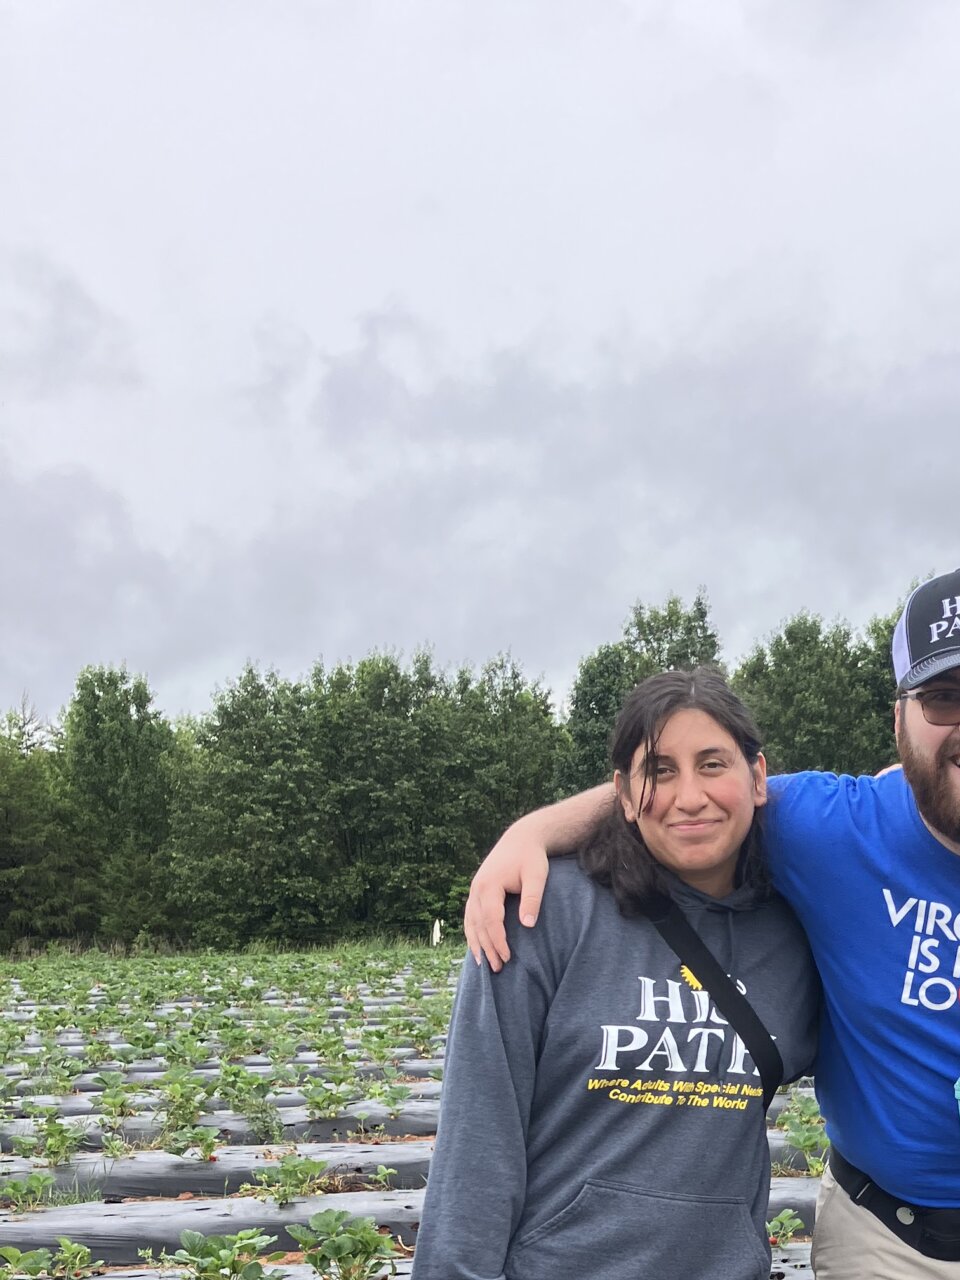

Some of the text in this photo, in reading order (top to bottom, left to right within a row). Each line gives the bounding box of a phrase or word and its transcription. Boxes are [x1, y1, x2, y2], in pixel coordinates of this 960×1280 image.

[908, 935, 940, 973] IS
[636, 975, 747, 1025] HI
[587, 1078, 629, 1090] Where
[631, 1079, 670, 1091] Adults
[609, 1088, 673, 1105] Contribute
[687, 1095, 710, 1107] The
[712, 1096, 748, 1110] World
